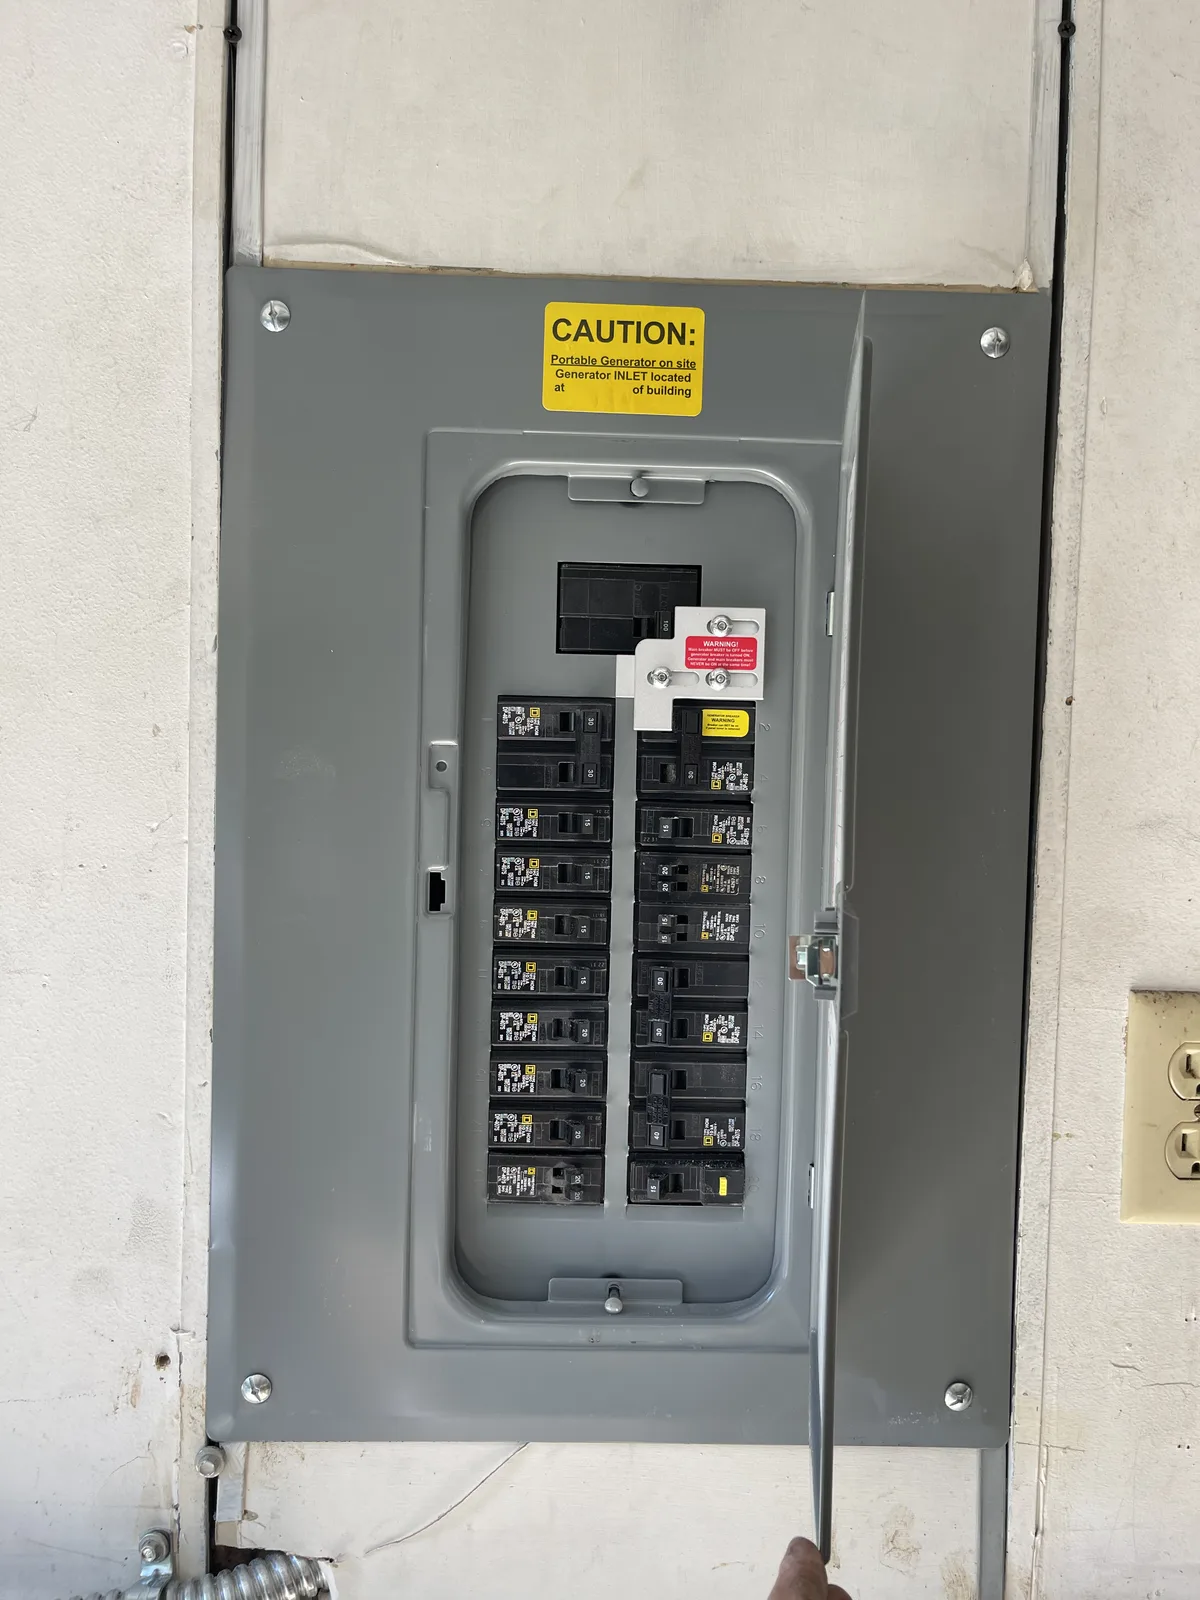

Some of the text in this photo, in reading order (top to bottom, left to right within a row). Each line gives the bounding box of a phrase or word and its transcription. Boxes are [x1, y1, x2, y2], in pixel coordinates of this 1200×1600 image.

[552, 318, 695, 346] CAUTION:
[551, 354, 597, 366] Portable
[600, 356, 656, 367] Generator
[676, 359, 696, 369] site
[556, 369, 691, 383] Generator INLET located
[554, 383, 692, 398] at of building
[587, 717, 594, 726] 30
[587, 769, 594, 778] 30
[688, 771, 694, 779] 30
[663, 824, 668, 833] 15
[662, 866, 668, 875] 20
[755, 875, 766, 884] 8
[663, 883, 668, 891] 20
[662, 917, 668, 925] 15
[581, 925, 586, 933] 15
[754, 923, 766, 939] 10
[662, 935, 668, 943] 15
[580, 976, 586, 985] 15
[658, 977, 664, 985] 30
[582, 1028, 588, 1037] 20
[656, 1028, 662, 1037] 30
[753, 1024, 764, 1040] 14
[580, 1079, 586, 1087] 20
[750, 1075, 762, 1091] 16
[575, 1130, 581, 1139] 20
[655, 1132, 660, 1140] 40
[750, 1129, 762, 1142] 18
[575, 1175, 581, 1184] 20
[575, 1192, 580, 1200] 20
